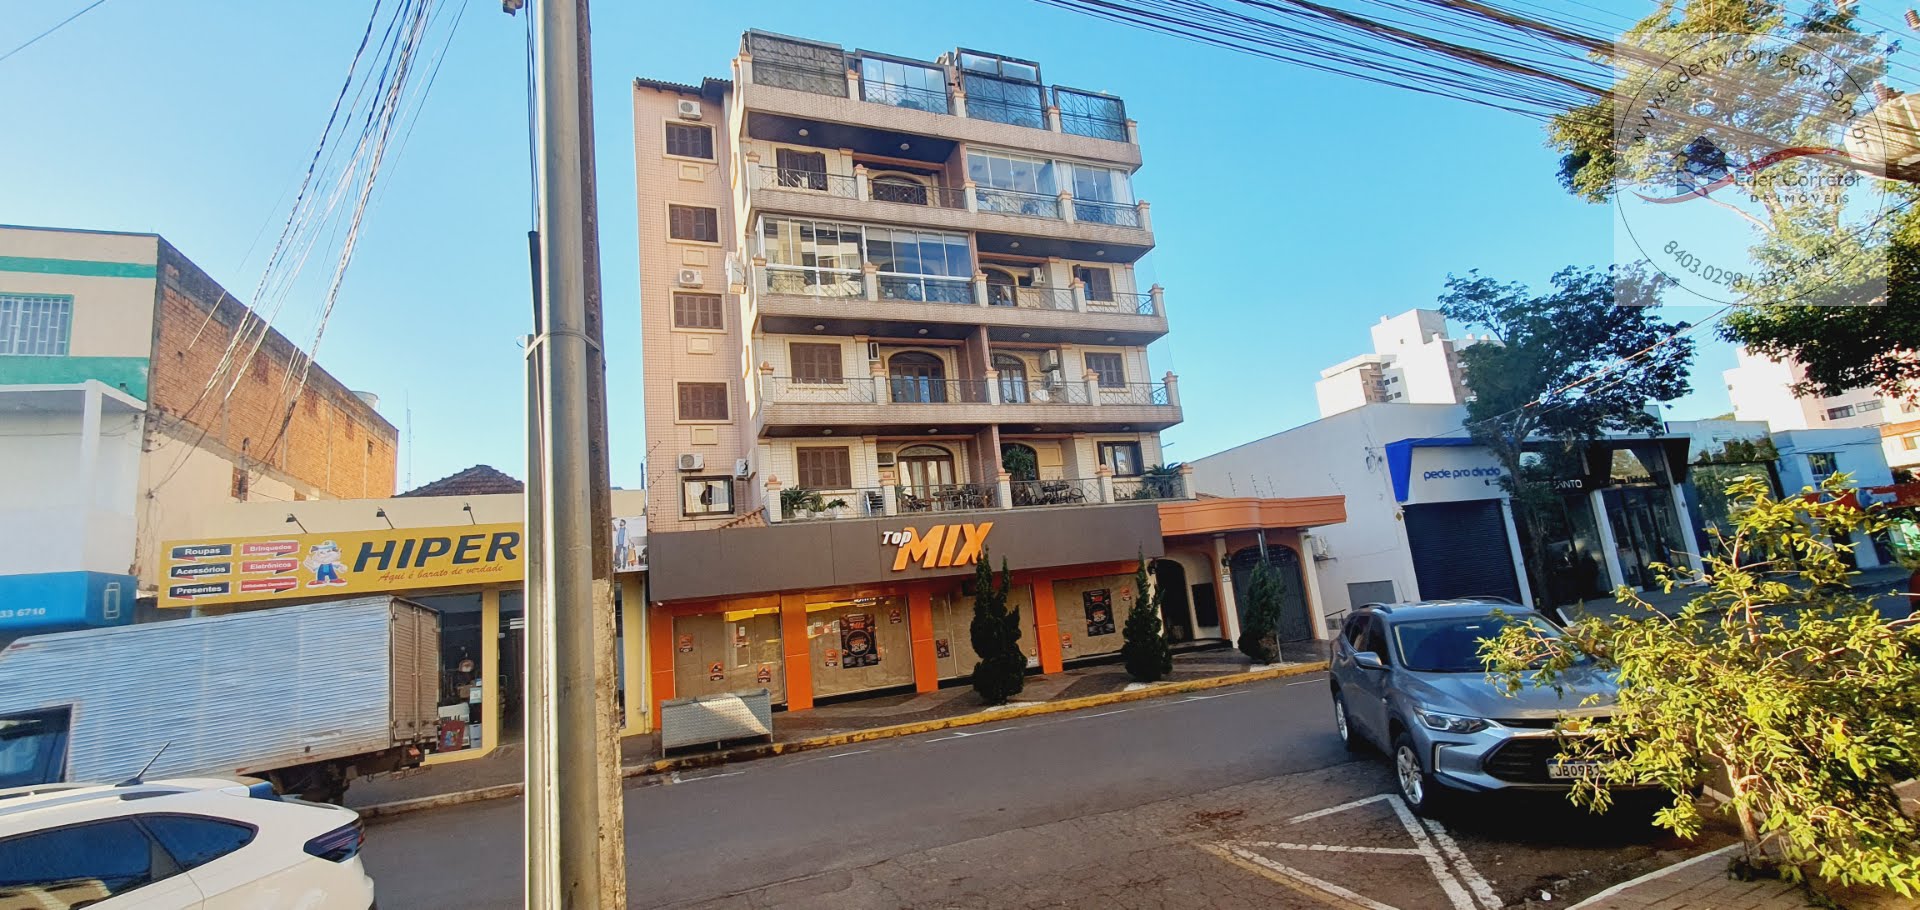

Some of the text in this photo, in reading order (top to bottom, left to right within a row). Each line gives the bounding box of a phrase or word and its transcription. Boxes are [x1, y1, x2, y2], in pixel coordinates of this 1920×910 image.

[1423, 466, 1501, 481] pede pro dindo
[184, 547, 221, 556] Roupas
[250, 544, 292, 552] Brinquedos
[893, 521, 994, 571] MIX
[353, 531, 521, 573] HIPER
[176, 565, 226, 575] Acessórios
[378, 571, 405, 584] Aqui
[417, 567, 448, 578] barato
[451, 567, 463, 575] de
[466, 562, 504, 574] verdade
[176, 584, 222, 595] Presentes
[17, 607, 46, 617] 6710
